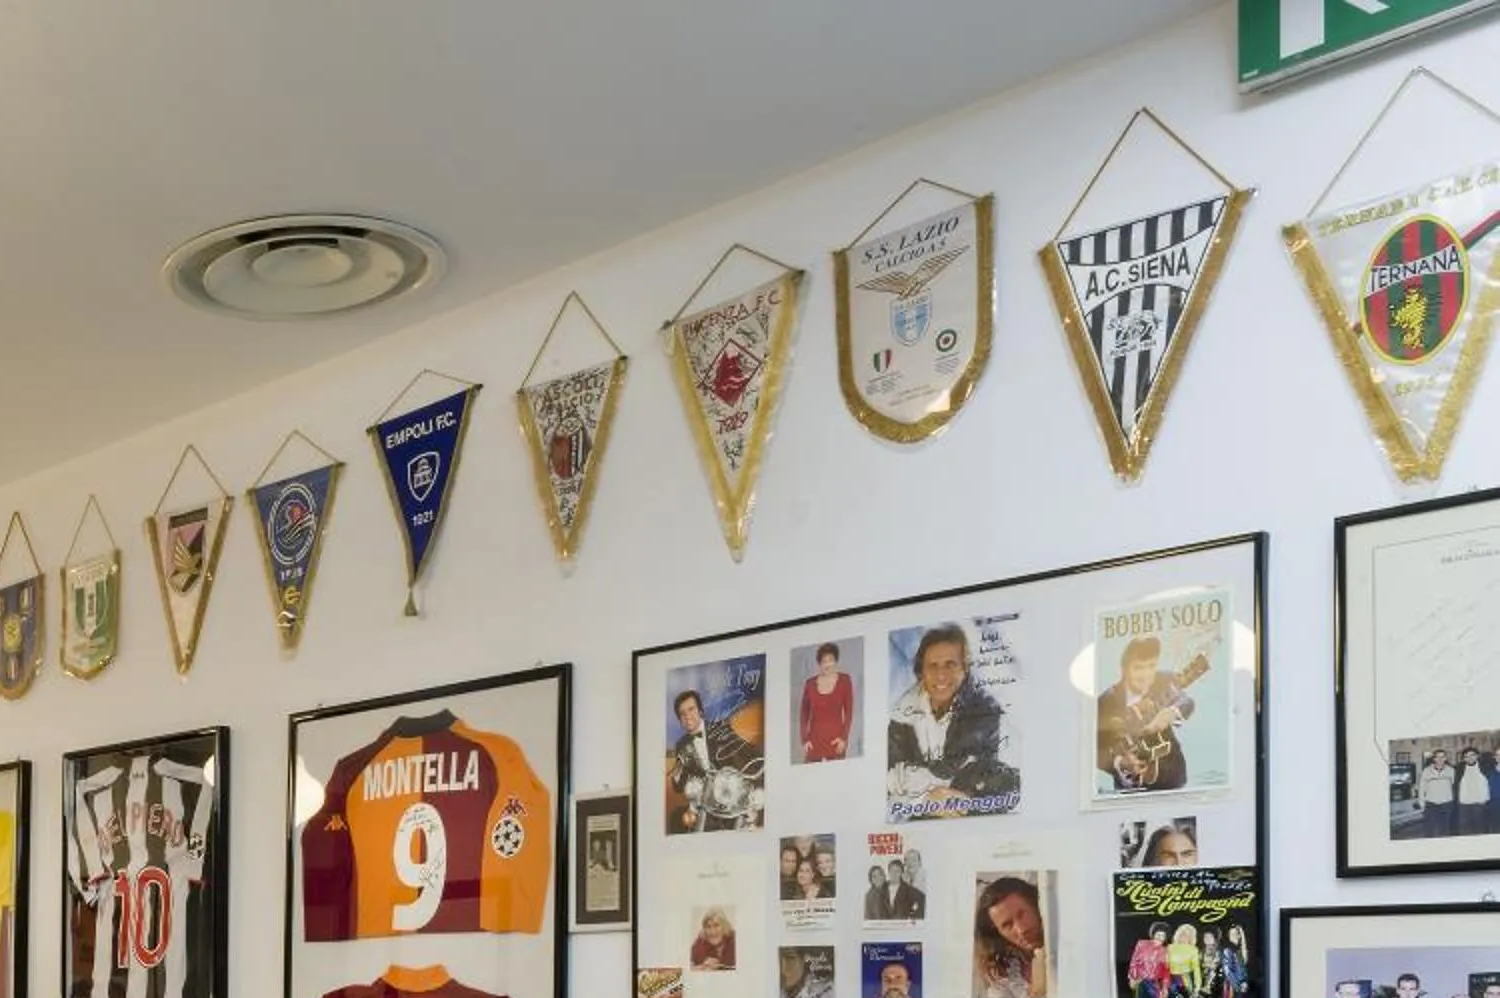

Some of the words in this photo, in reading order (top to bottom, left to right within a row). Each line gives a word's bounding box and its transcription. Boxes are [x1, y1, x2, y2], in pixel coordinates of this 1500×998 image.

[900, 215, 961, 250] LAZIO
[1371, 246, 1463, 292] TERNANA
[386, 419, 433, 449] EMPOLI
[1104, 608, 1164, 639] BOBBY
[1171, 599, 1222, 628] SOLO
[363, 750, 479, 801] MONTELLA
[891, 799, 940, 816] Paolo
[943, 791, 1021, 814] Mengoli
[392, 802, 447, 931] 9
[114, 865, 172, 968] 10
